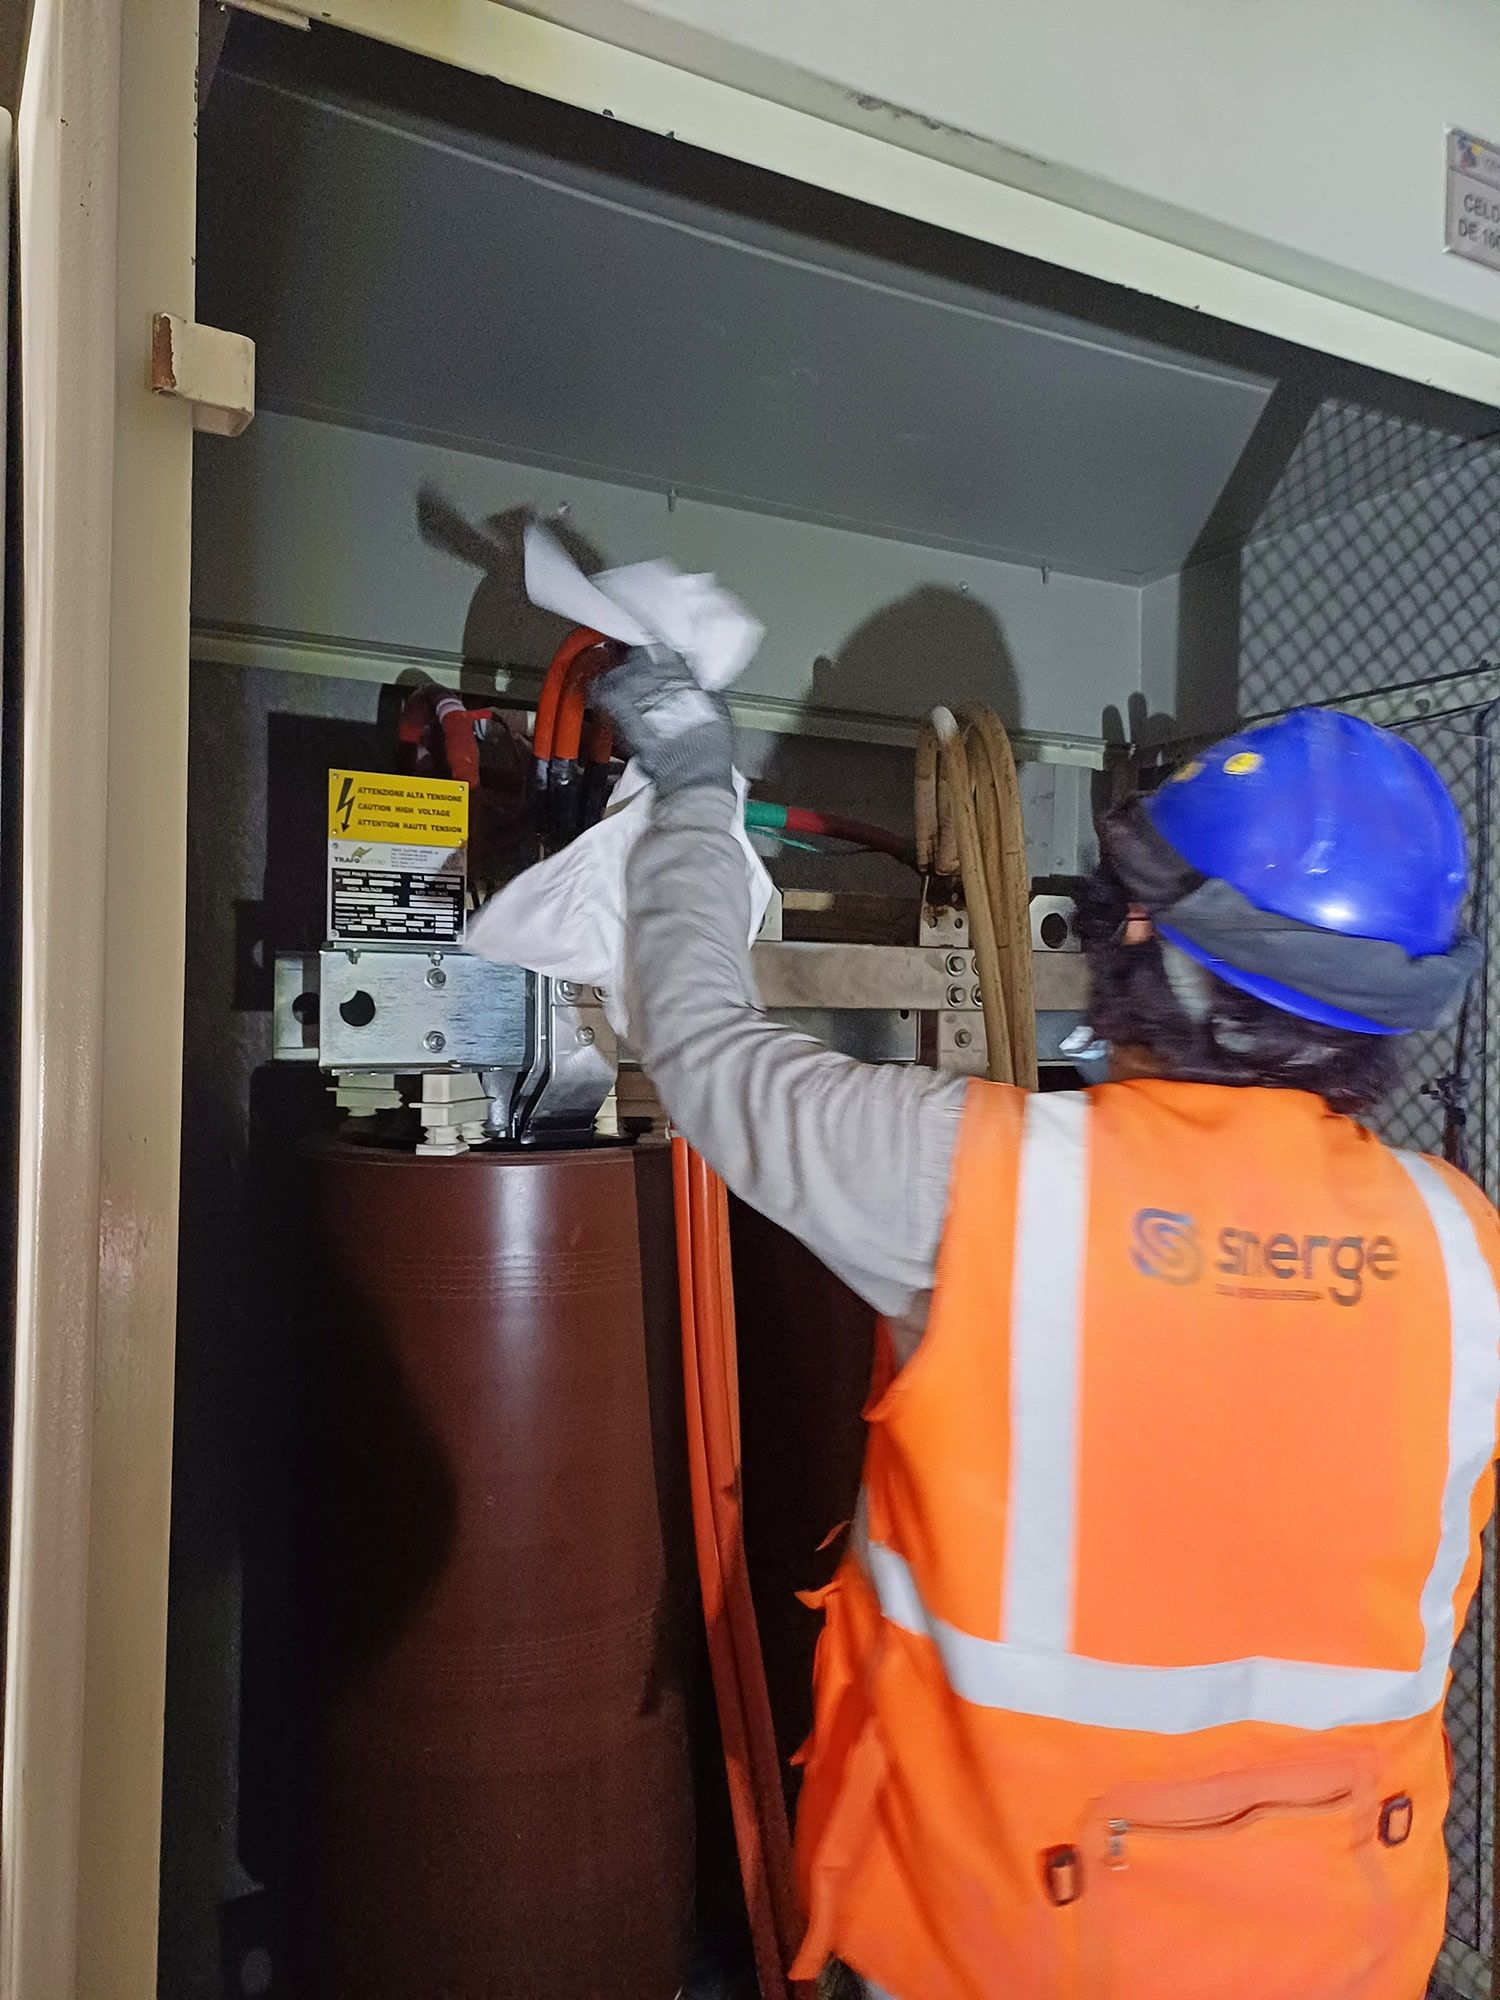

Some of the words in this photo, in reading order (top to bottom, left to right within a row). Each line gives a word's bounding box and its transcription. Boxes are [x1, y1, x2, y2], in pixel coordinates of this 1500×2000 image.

[1458, 218, 1478, 242] DE
[358, 786, 404, 798] ATTENZIONE
[406, 791, 424, 799] ALTA
[426, 793, 463, 803] TENSIONE
[358, 803, 391, 812] CAUTION
[395, 806, 414, 814] HIGH
[418, 808, 450, 817] VOLTAGE
[357, 819, 400, 828] ATTENTION
[403, 822, 428, 831] HAUTE
[431, 824, 463, 833] TENSION
